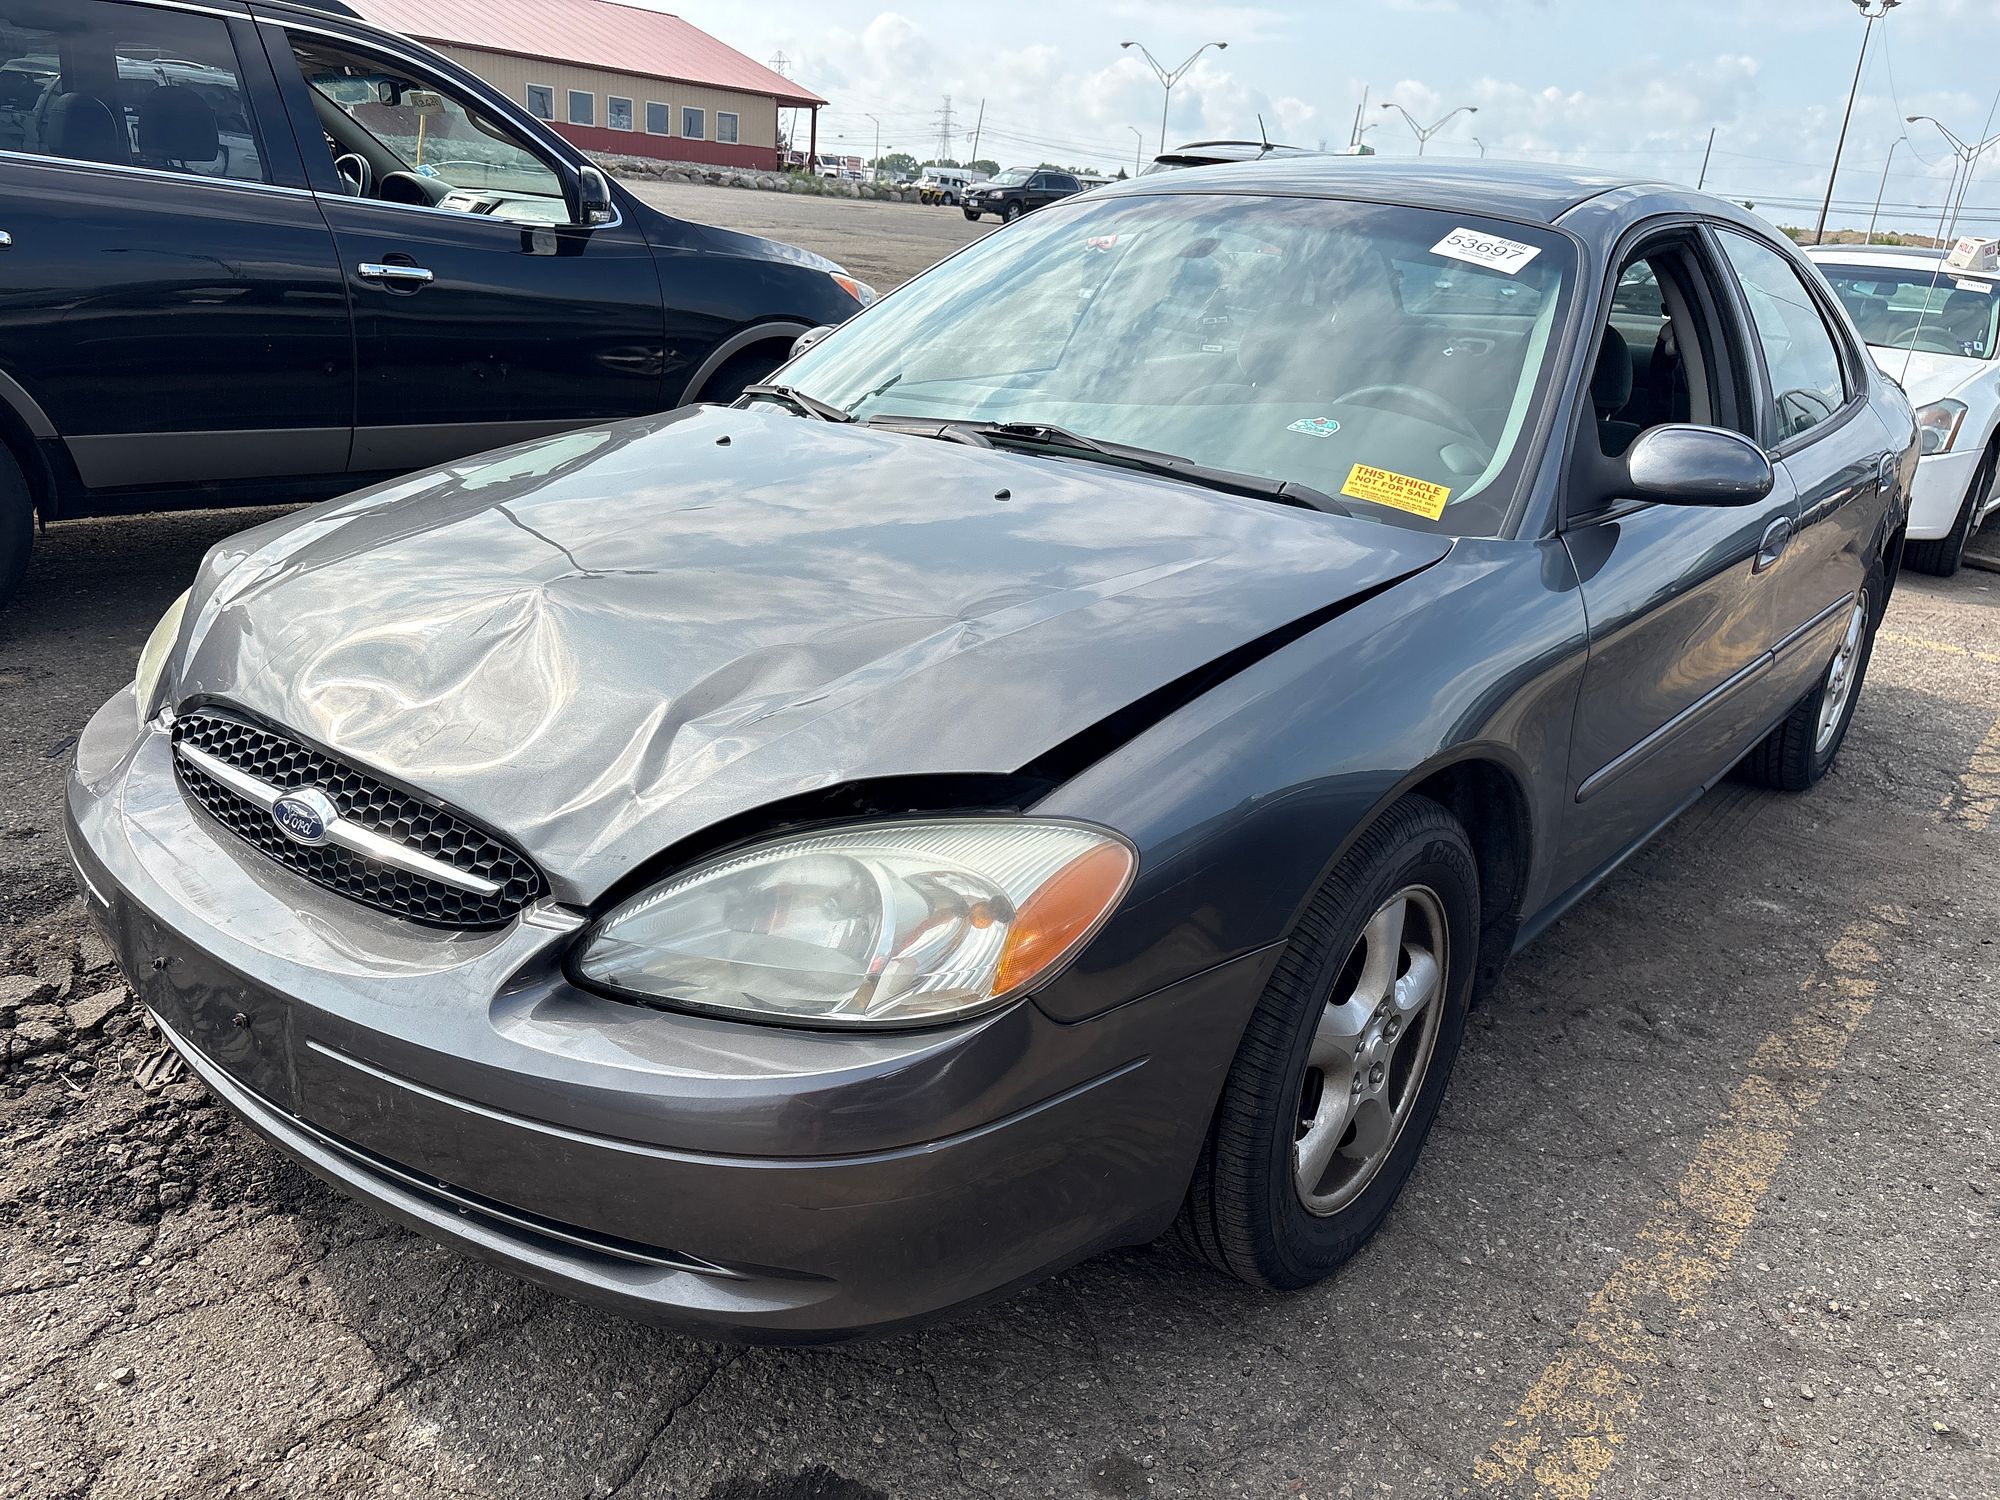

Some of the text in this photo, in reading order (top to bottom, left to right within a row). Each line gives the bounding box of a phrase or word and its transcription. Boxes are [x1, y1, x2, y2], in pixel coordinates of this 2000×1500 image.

[1447, 235, 1525, 260] 53697
[1355, 475, 1436, 502] NOT FOR SALE
[1357, 466, 1385, 480] THIS
[1389, 474, 1442, 496] VEHICLE
[282, 803, 317, 835] Ford
